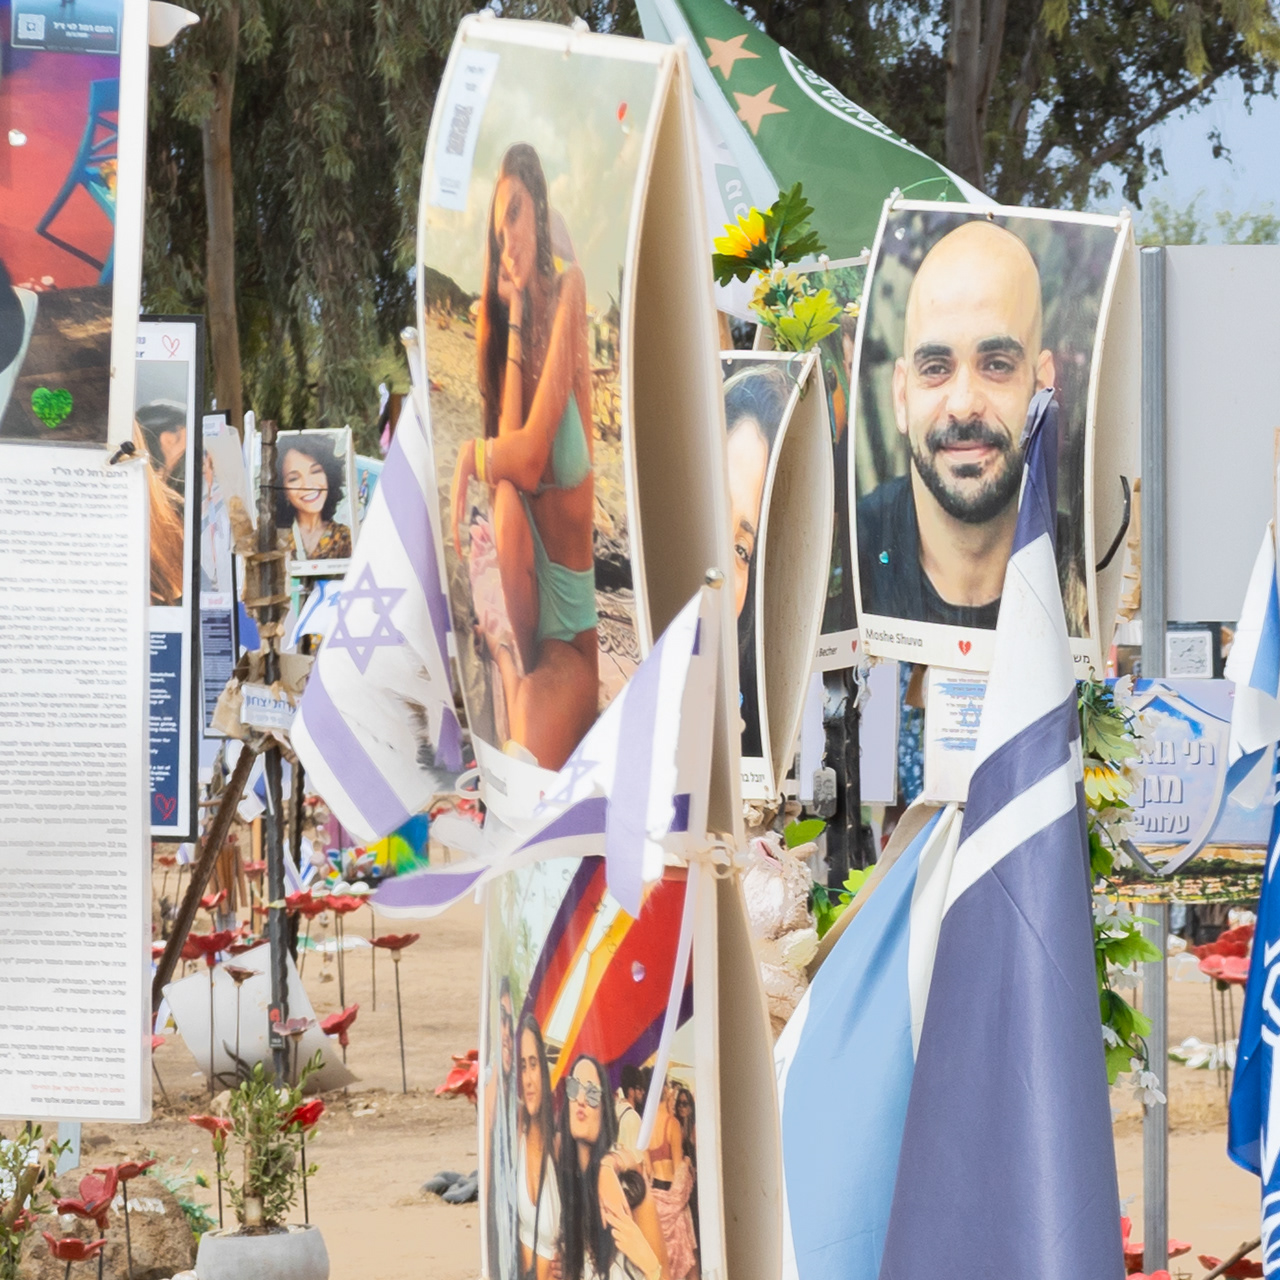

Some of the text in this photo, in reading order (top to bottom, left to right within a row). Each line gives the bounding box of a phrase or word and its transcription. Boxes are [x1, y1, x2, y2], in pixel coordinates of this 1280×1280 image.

[865, 627, 924, 648] Moshe Shuva
[1073, 653, 1091, 664] מש
[1140, 774, 1184, 809] מגן
